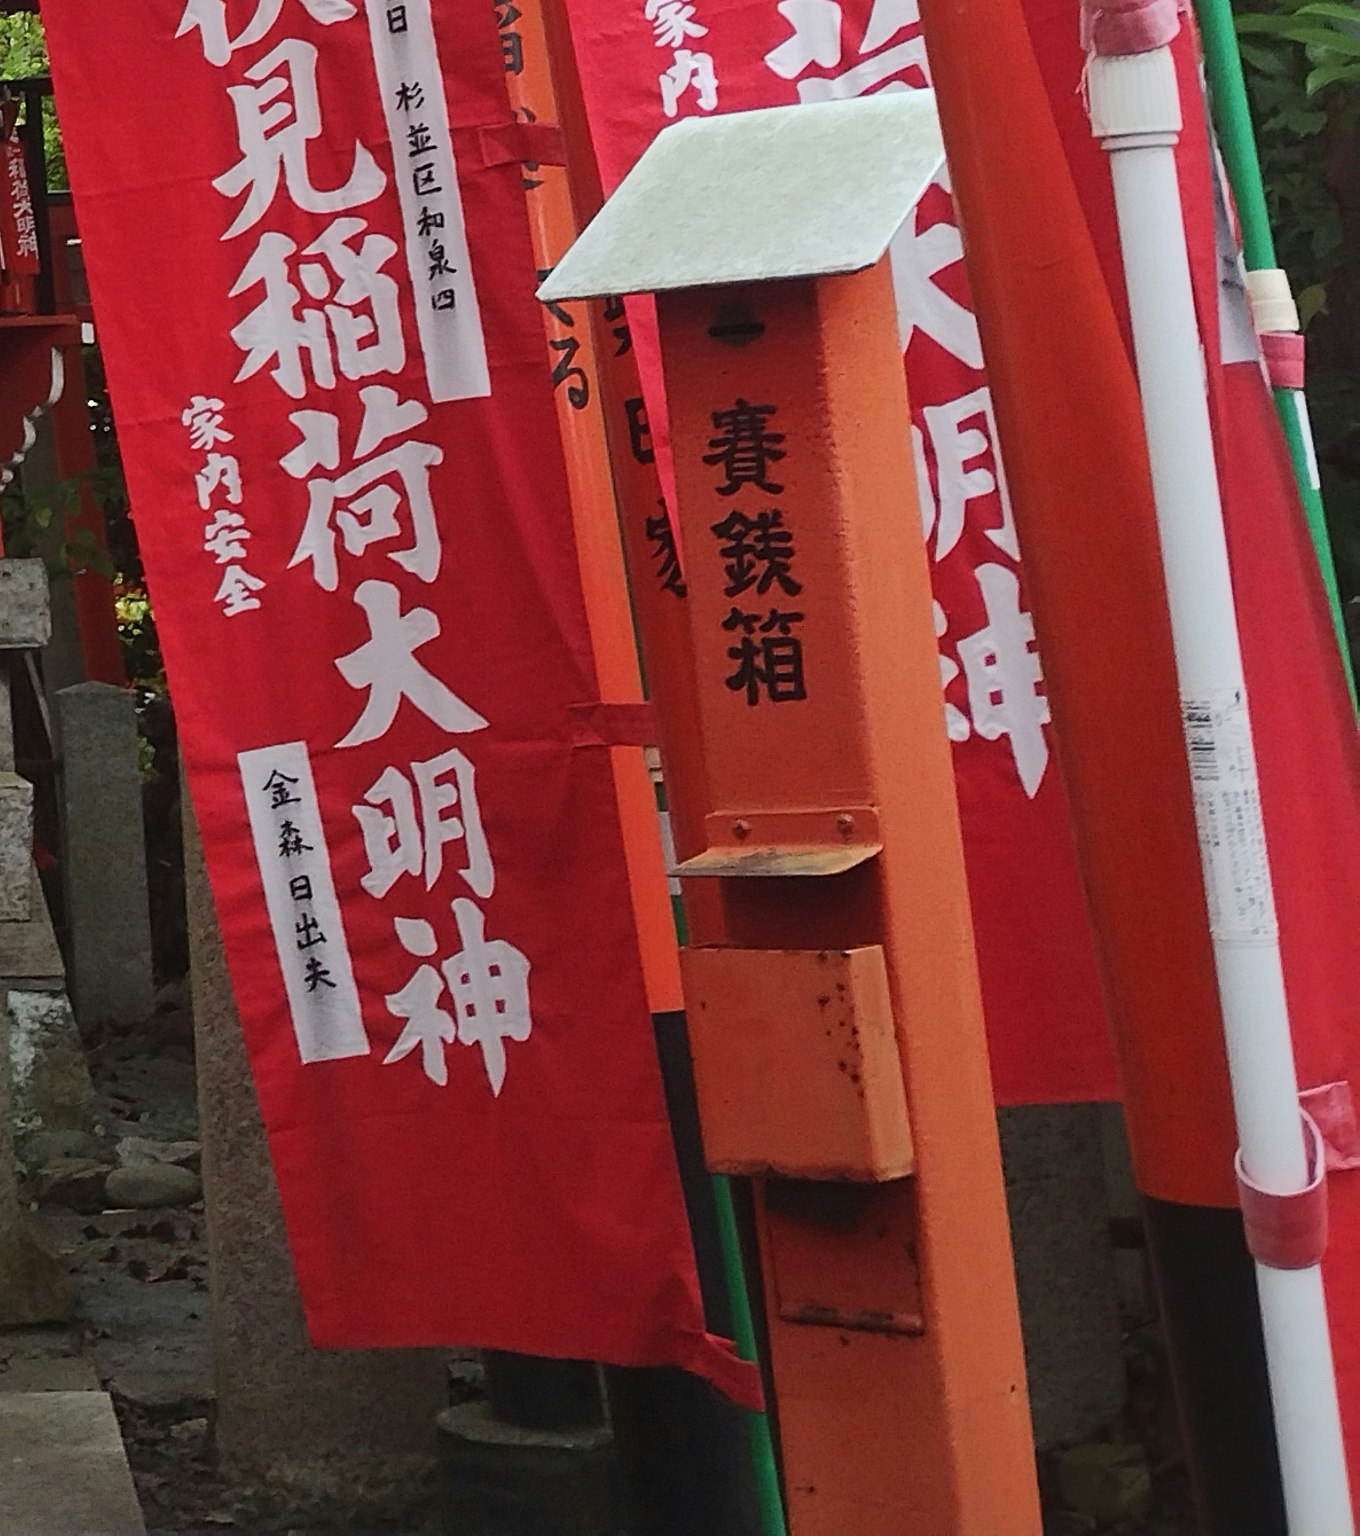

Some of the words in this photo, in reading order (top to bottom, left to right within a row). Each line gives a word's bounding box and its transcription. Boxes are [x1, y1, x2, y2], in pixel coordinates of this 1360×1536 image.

[395, 81, 458, 313] 杉並区和泉四
[182, 395, 267, 617] 家内安全
[262, 769, 337, 992] 金森日出夫
